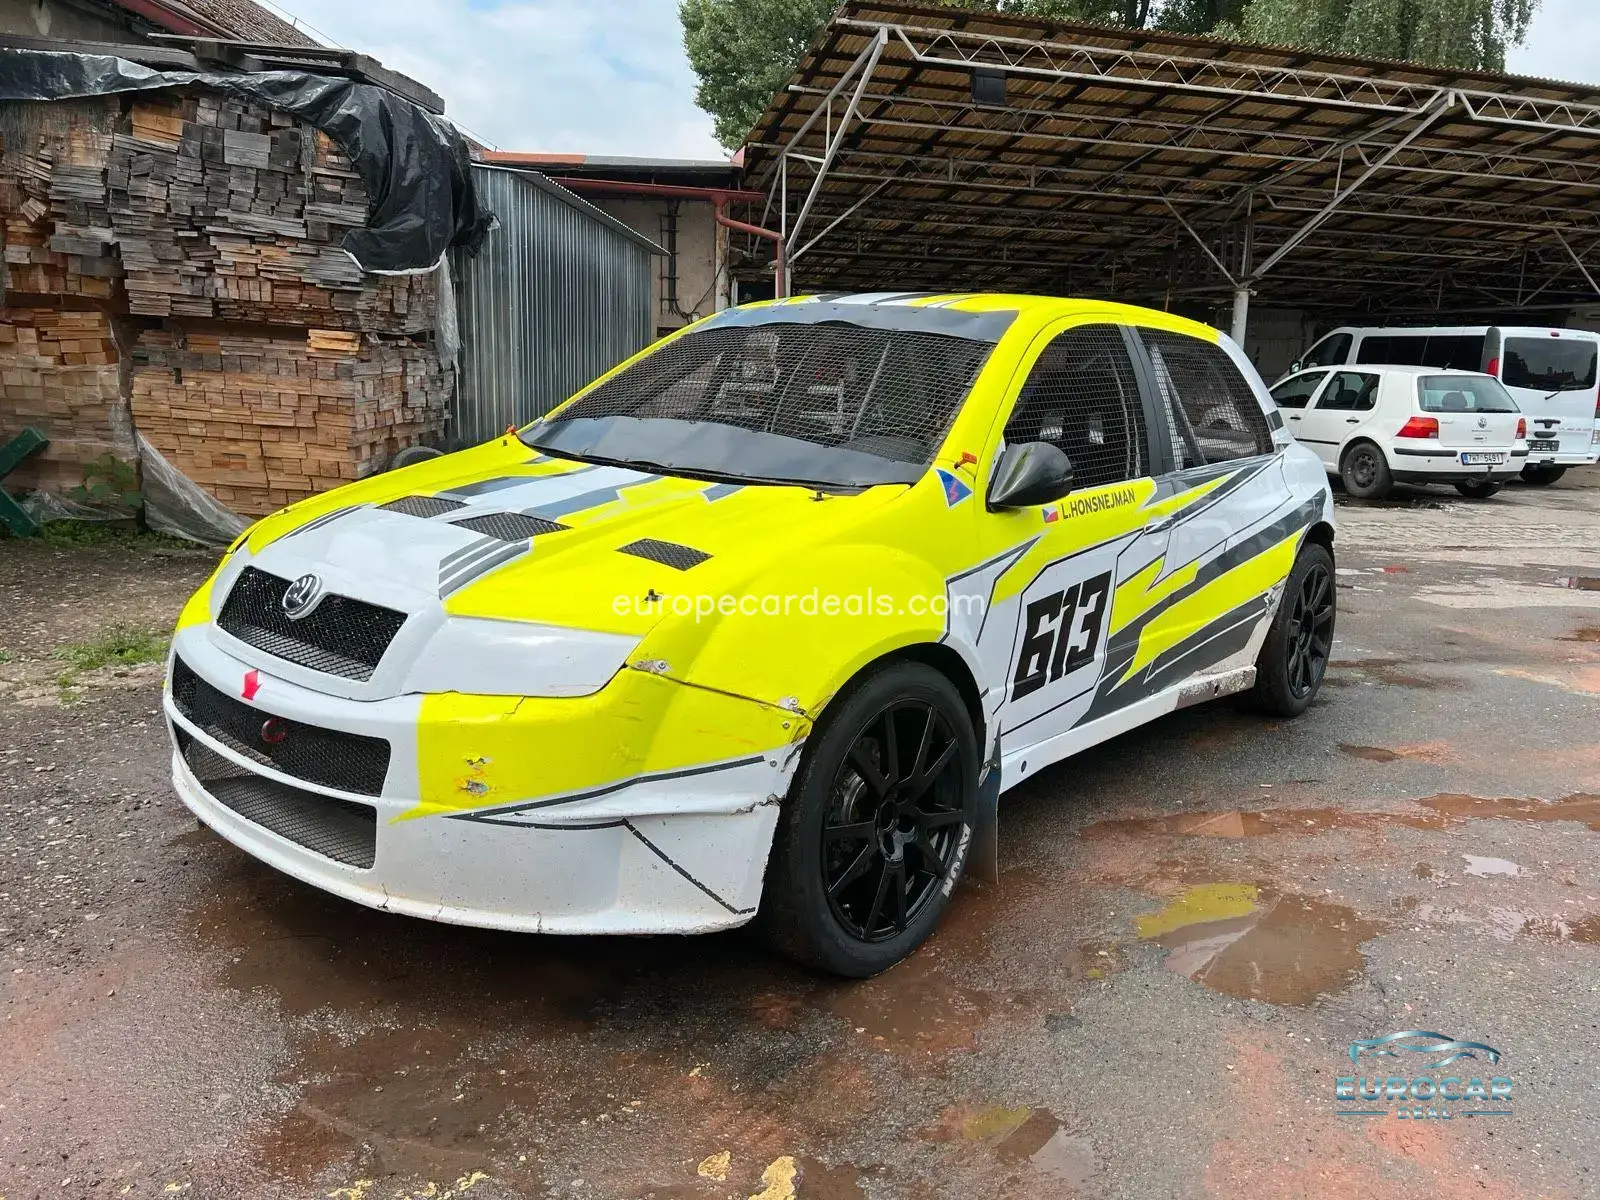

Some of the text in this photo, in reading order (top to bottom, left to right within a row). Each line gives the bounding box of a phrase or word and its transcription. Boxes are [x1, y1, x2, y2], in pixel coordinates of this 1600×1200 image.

[1061, 487, 1136, 520] L.HONSNEJMAN
[1010, 569, 1113, 703] 613
[941, 822, 971, 899] AVON
